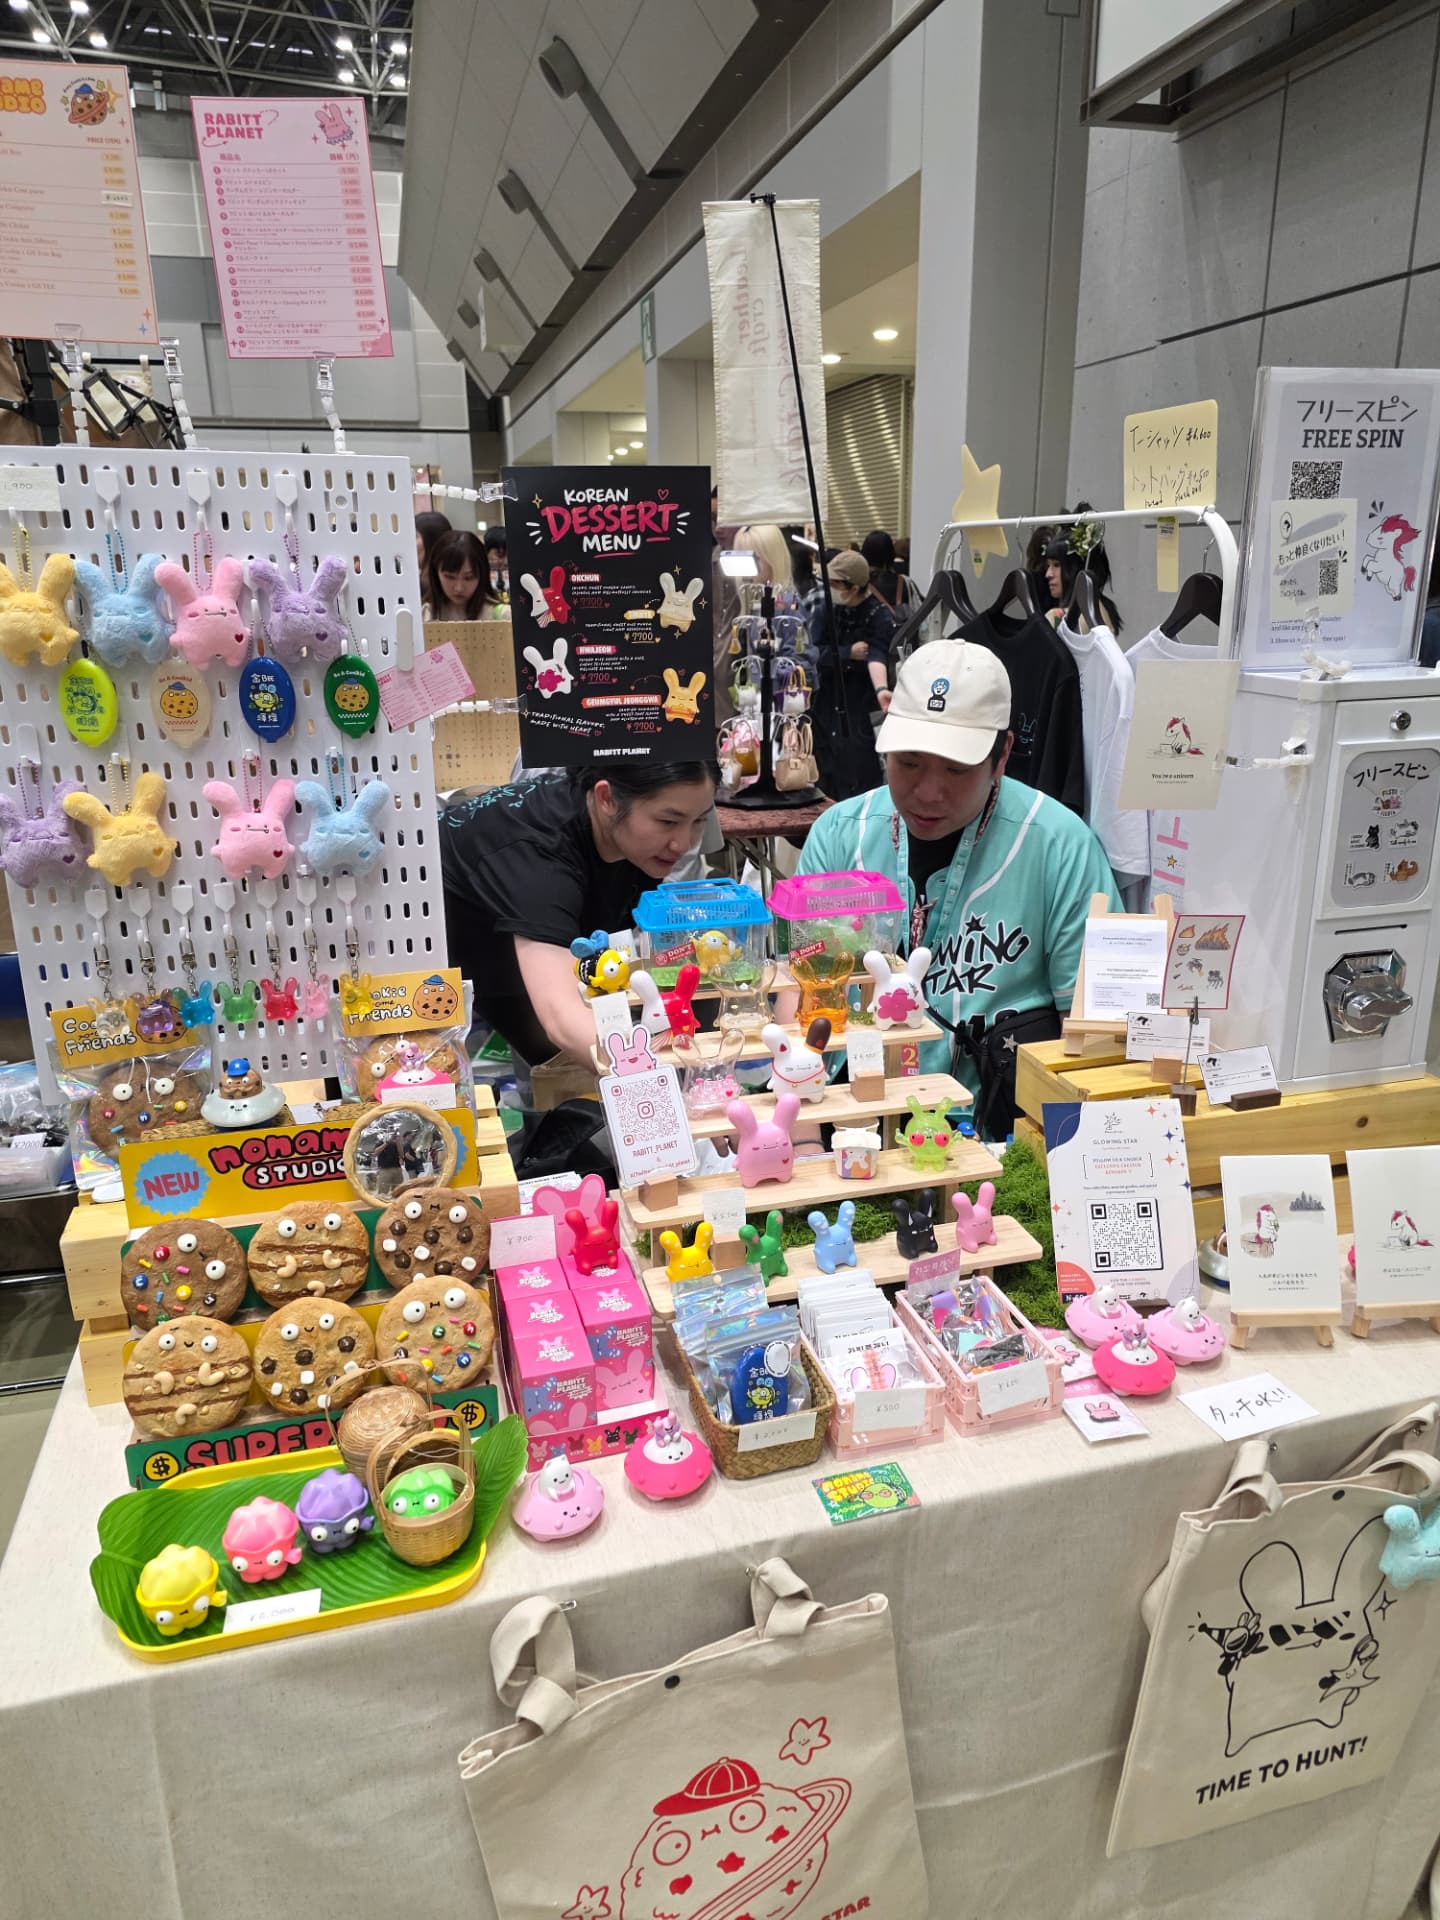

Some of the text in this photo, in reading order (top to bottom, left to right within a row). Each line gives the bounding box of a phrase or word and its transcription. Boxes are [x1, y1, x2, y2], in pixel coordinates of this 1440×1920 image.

[204, 113, 262, 126] RABITT
[206, 127, 264, 139] PLANET
[1297, 395, 1419, 423] フリースピン
[1302, 429, 1404, 449] FREE SPIN
[564, 488, 629, 506] KOREAN
[541, 501, 679, 543] DESSERT
[583, 533, 641, 553] MENU
[926, 963, 998, 995] TAR
[208, 1128, 351, 1175] nonam
[142, 1171, 200, 1200] NEW
[1195, 1736, 1369, 1805] TIME TO HUNT!
